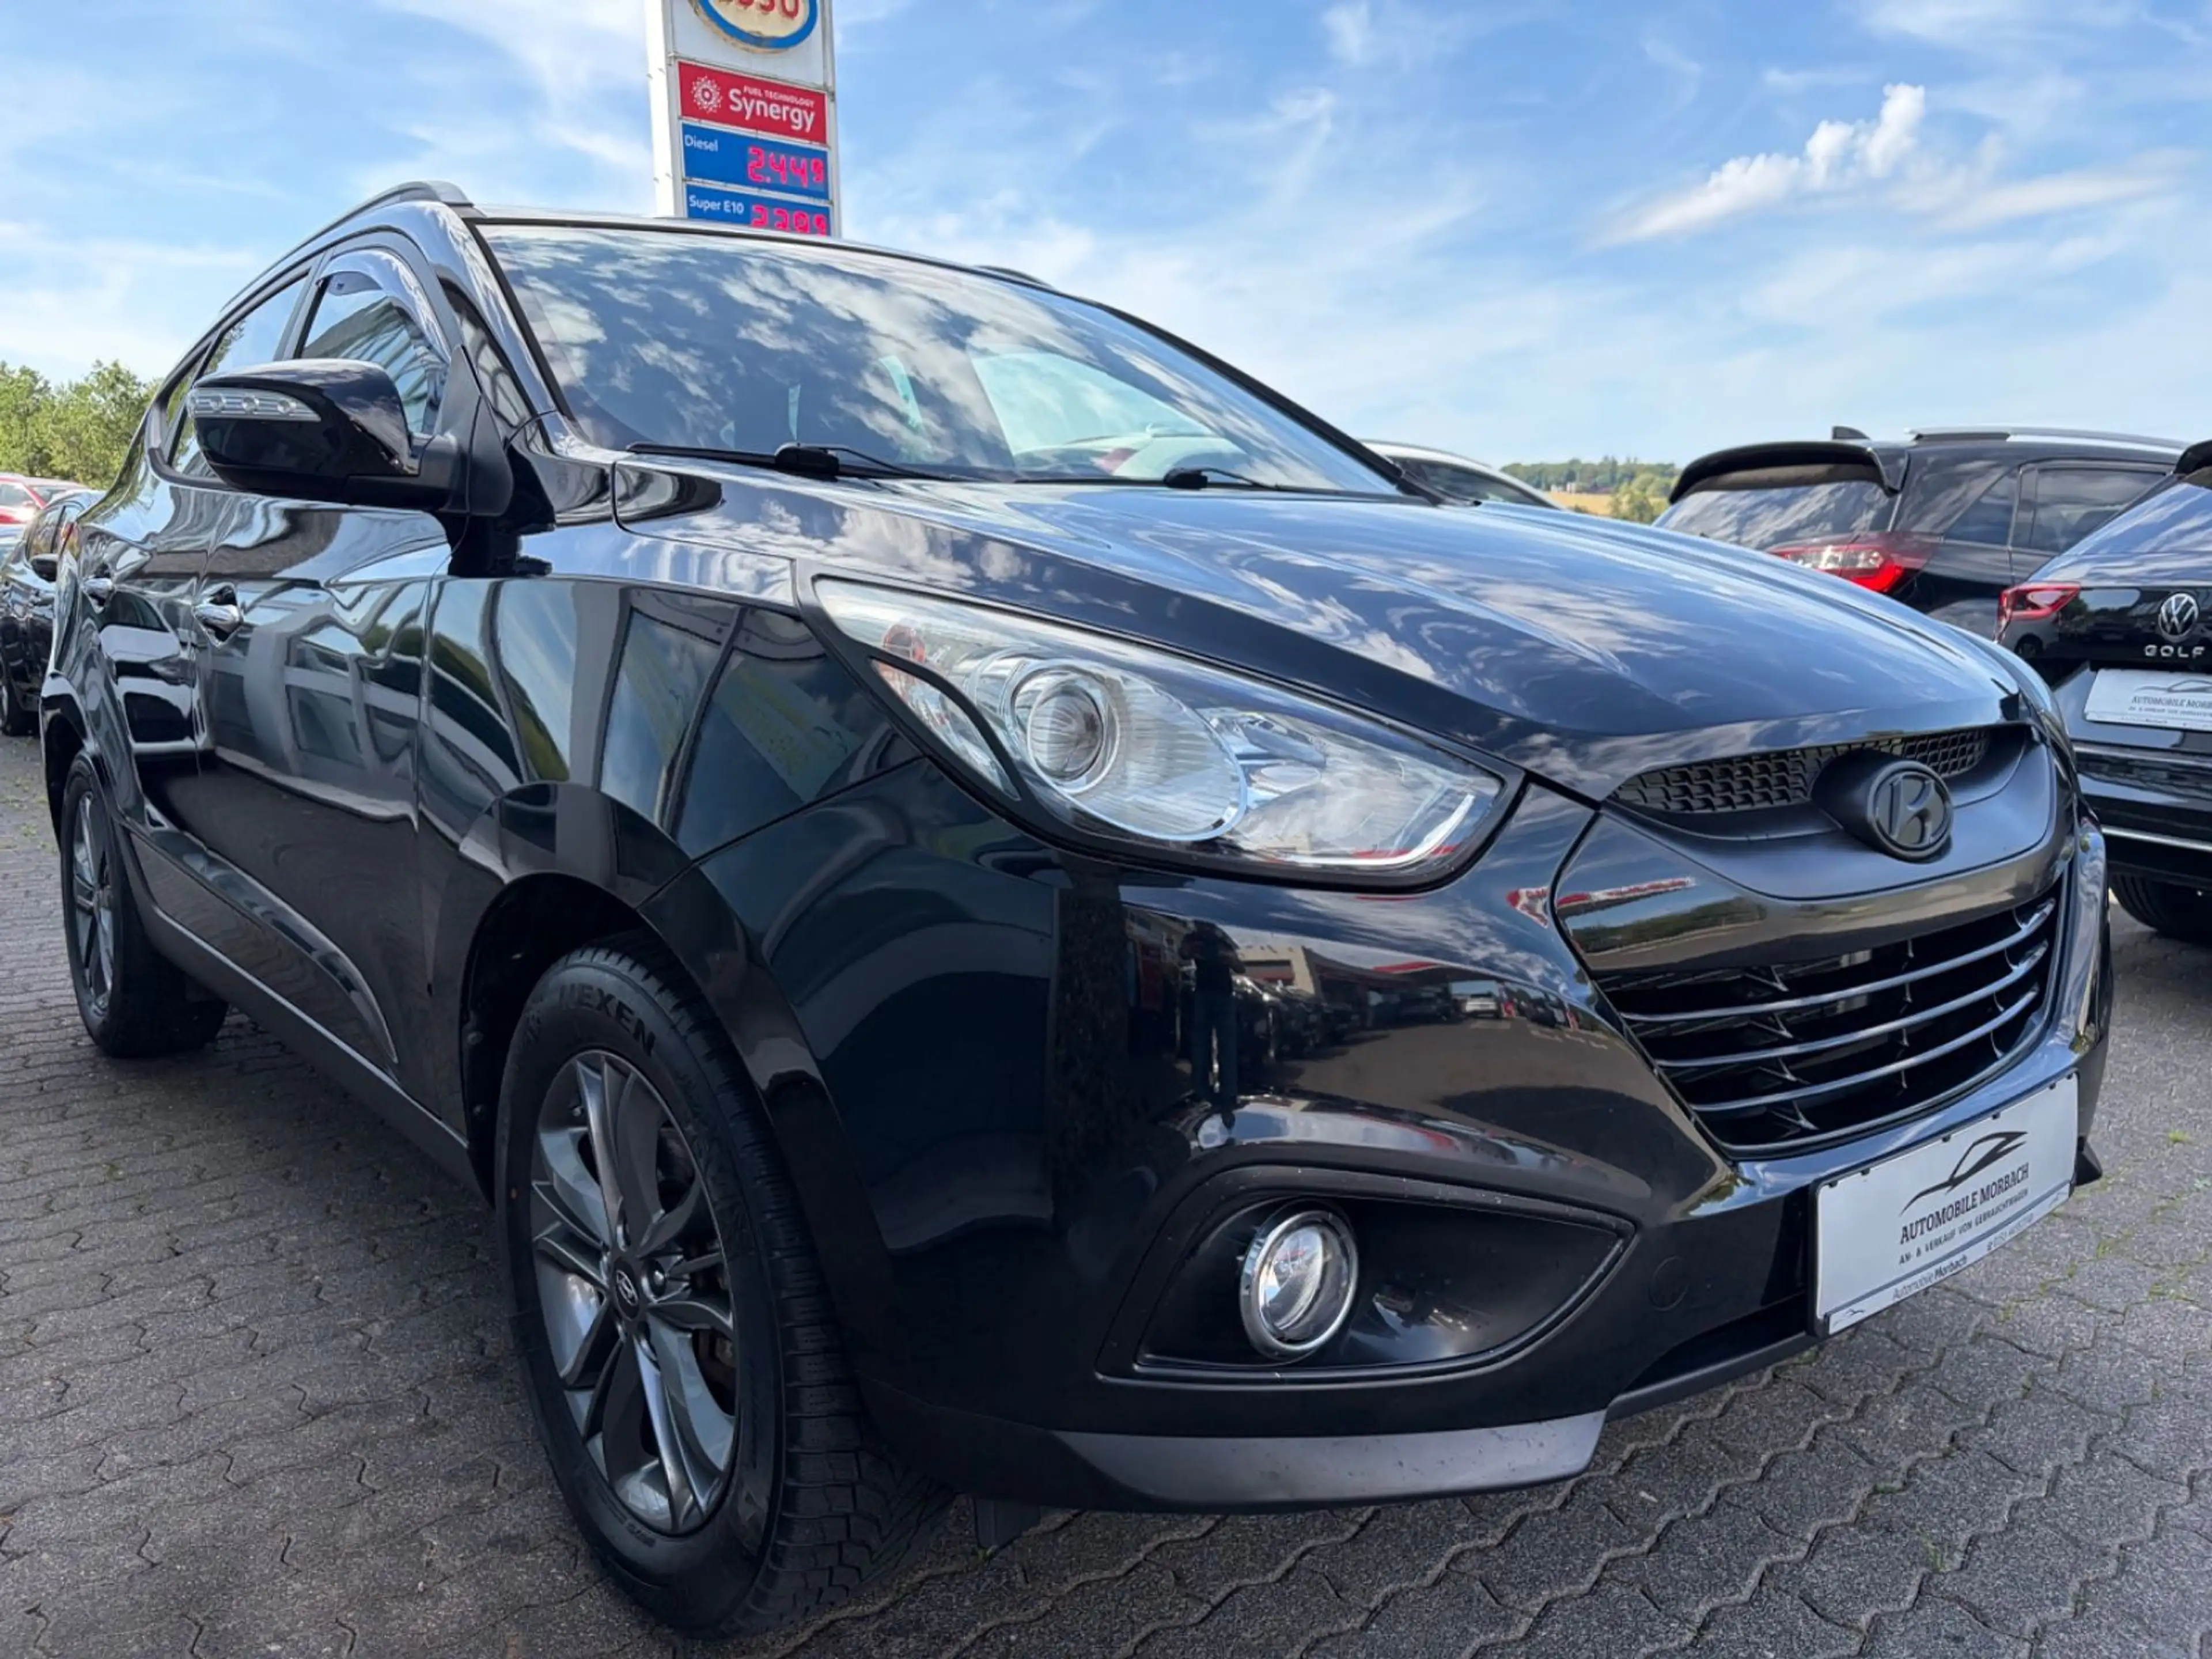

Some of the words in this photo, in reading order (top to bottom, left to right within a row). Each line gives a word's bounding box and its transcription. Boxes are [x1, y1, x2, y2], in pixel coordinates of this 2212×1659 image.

[729, 88, 815, 132] Synergy
[684, 135, 718, 152] Diesel
[689, 195, 721, 214] Super
[724, 200, 745, 215] E10
[2145, 644, 2205, 658] GOLF
[559, 983, 656, 1056] NEXEN
[1900, 1190, 1978, 1245] AUTOMOBILE
[1979, 1162, 2029, 1205] MORBACH
